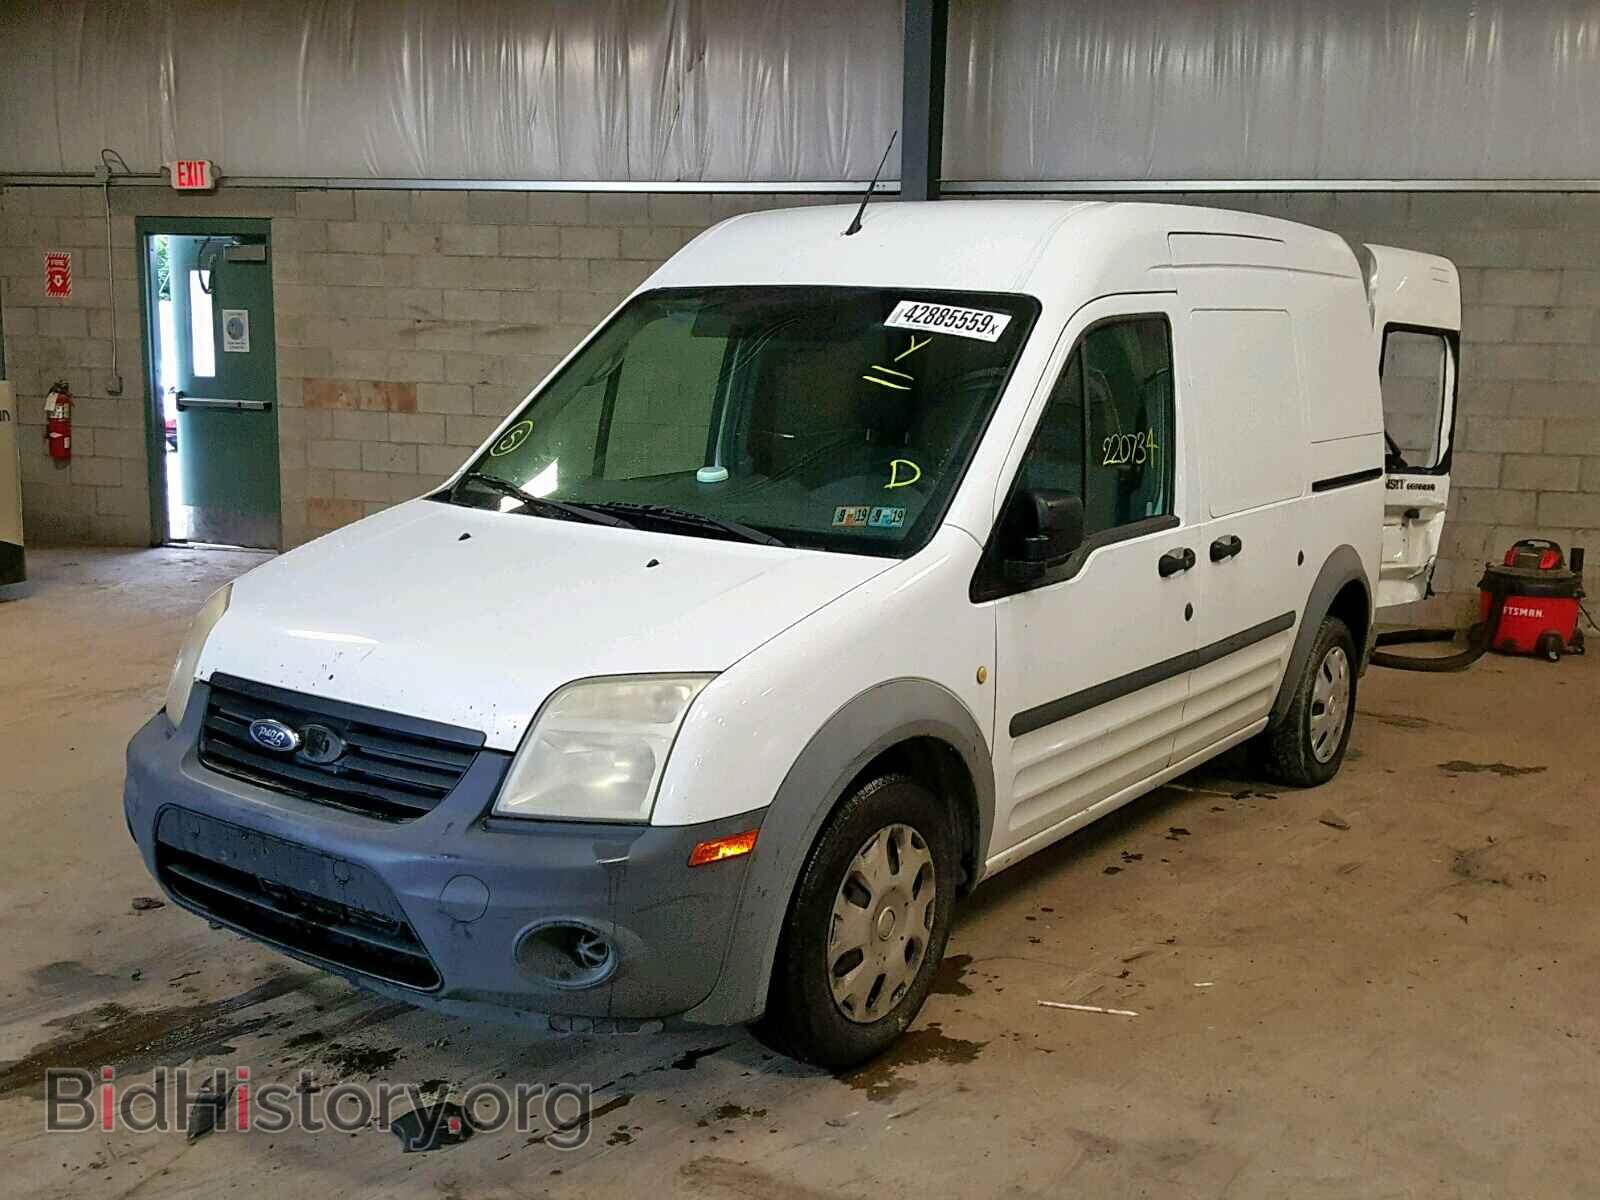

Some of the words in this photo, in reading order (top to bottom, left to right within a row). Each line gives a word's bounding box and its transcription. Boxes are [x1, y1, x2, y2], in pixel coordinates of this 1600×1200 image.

[178, 161, 206, 187] EXIT
[1102, 427, 1160, 469] 220734
[884, 459, 921, 488] D
